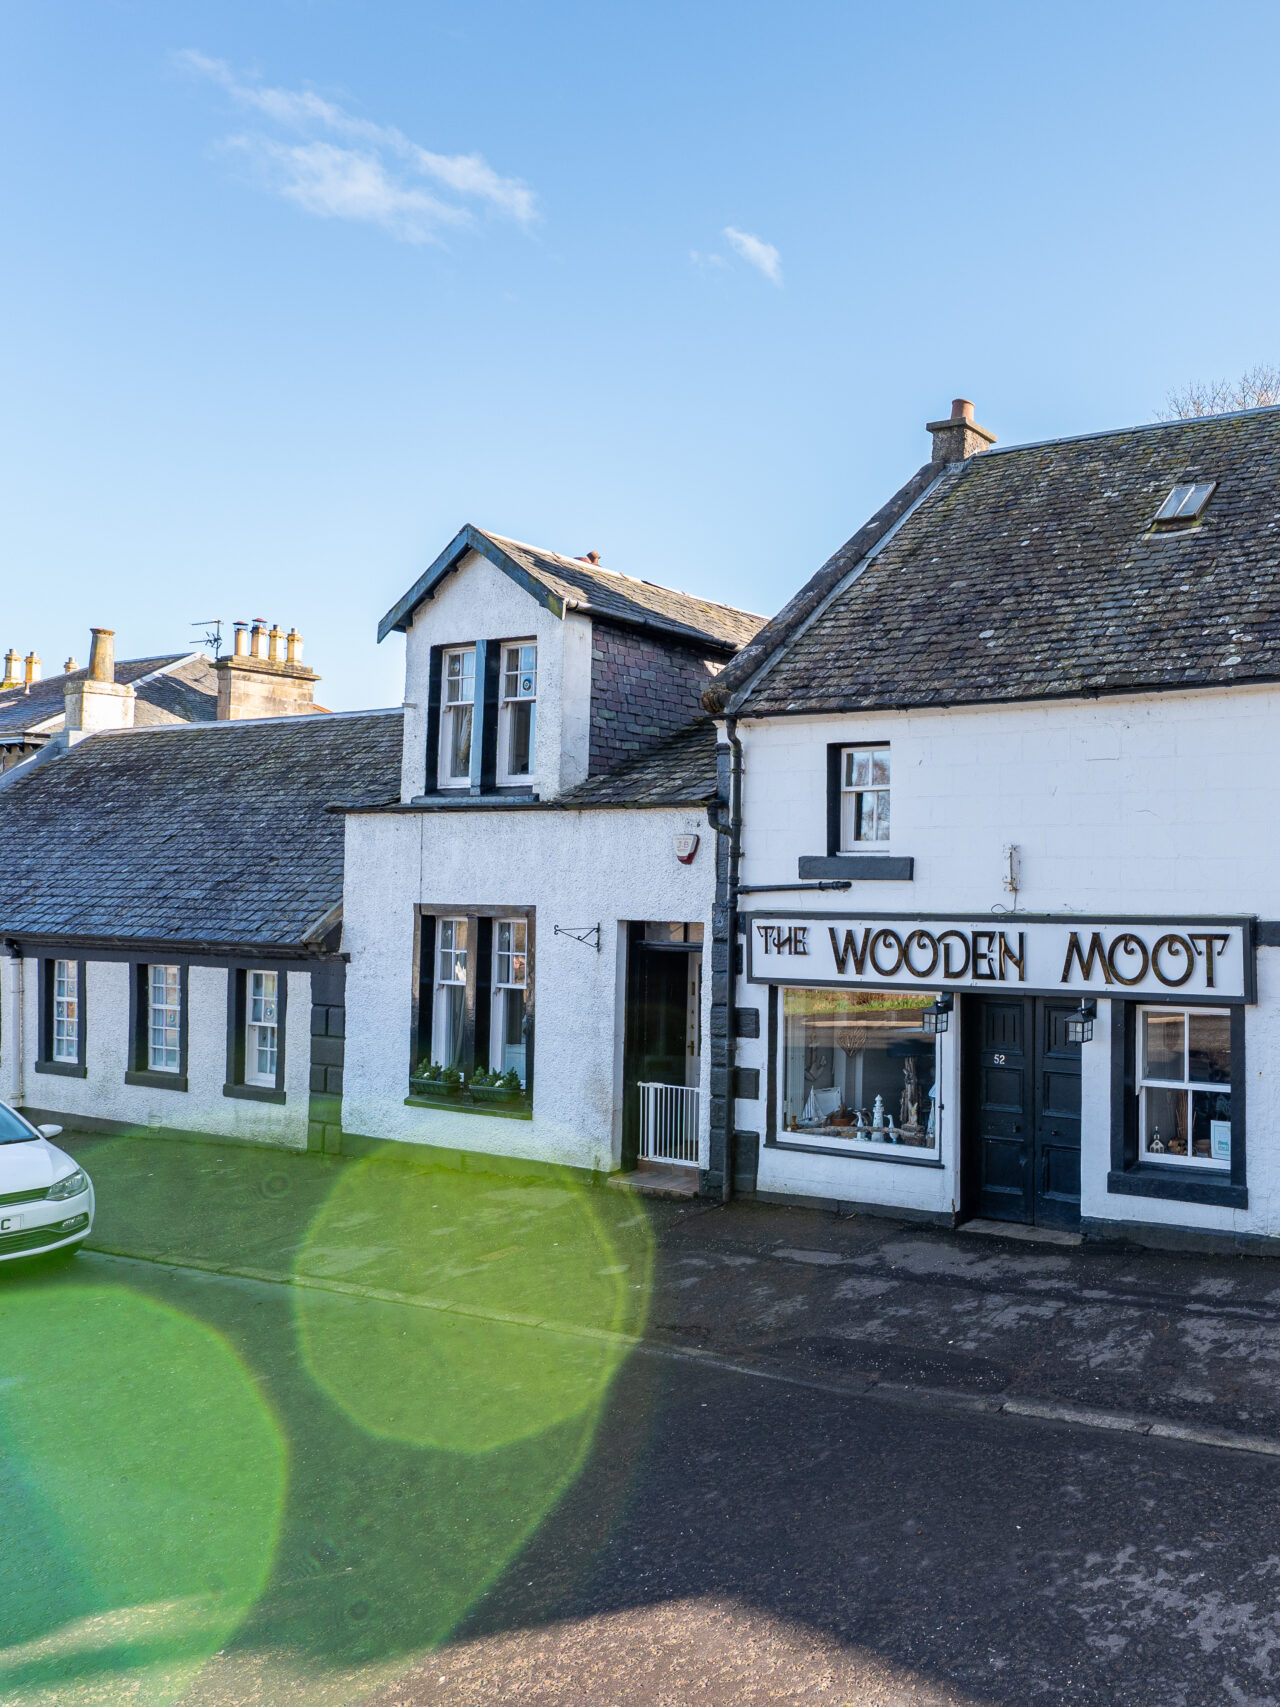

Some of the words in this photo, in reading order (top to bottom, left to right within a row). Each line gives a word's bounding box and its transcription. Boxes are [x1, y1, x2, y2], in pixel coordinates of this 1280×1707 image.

[757, 926, 808, 955] THE
[828, 927, 1025, 981] WOODEN
[1060, 931, 1230, 988] MOOT
[994, 1054, 1005, 1065] 52
